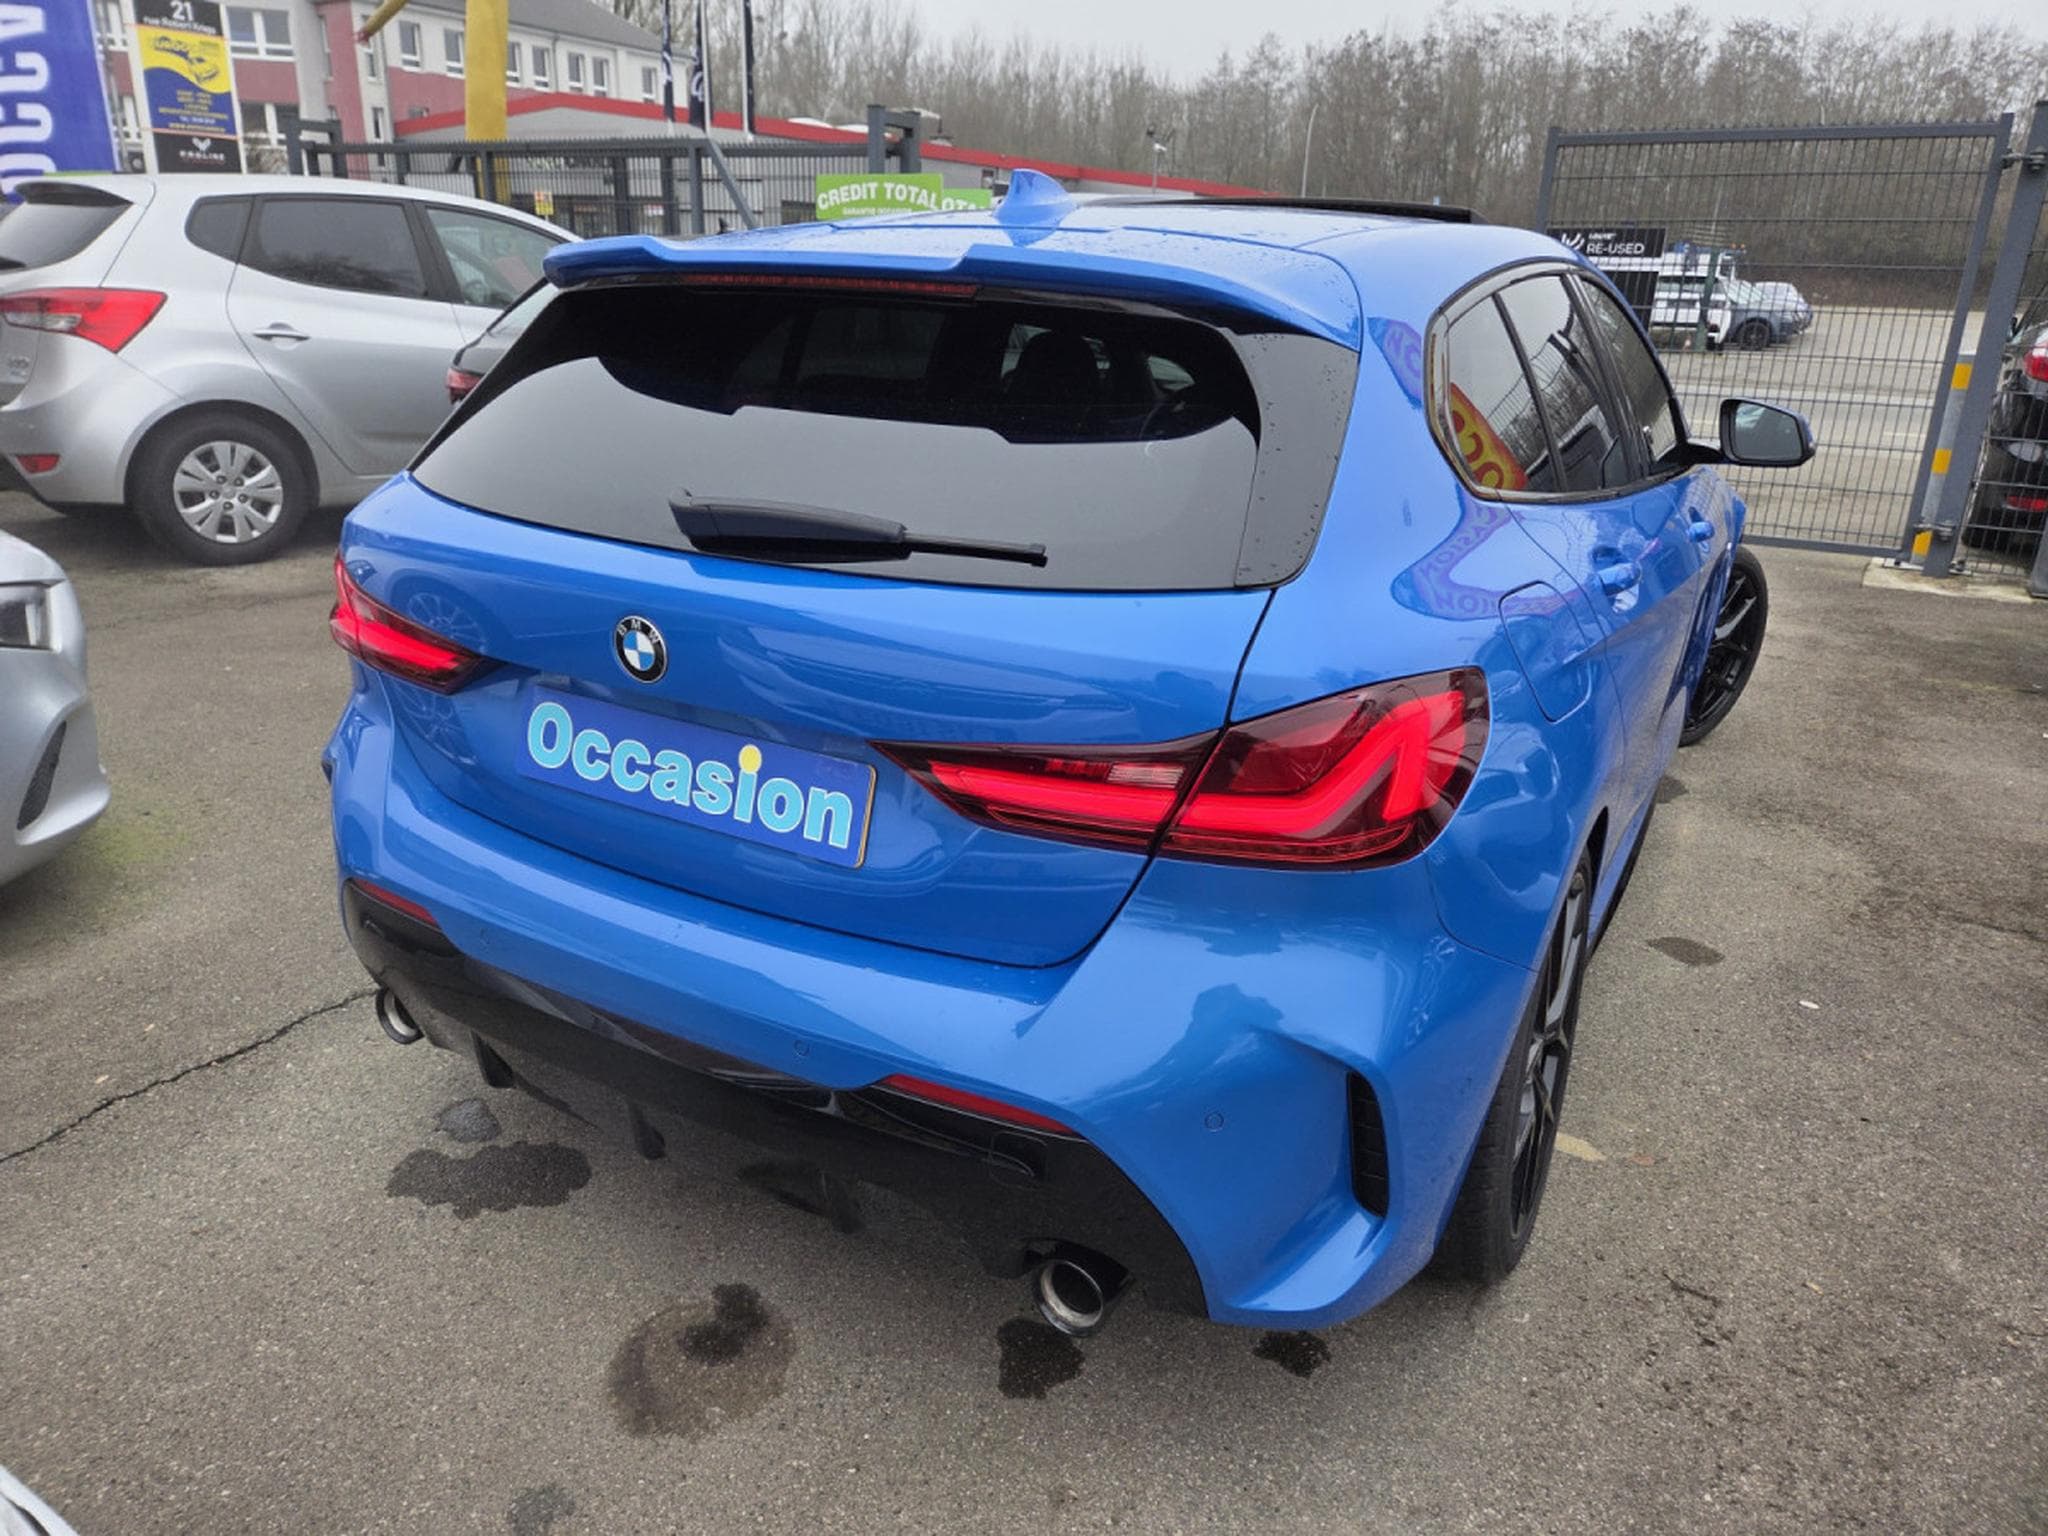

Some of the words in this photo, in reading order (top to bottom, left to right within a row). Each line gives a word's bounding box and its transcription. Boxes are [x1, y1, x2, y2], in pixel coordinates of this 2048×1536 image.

[170, 0, 195, 21] 21
[816, 182, 879, 211] CREDIT
[883, 182, 940, 211] TOTAL
[1586, 243, 1645, 255] RE-USED
[616, 618, 660, 645] BMW
[527, 701, 854, 850] Occasion
